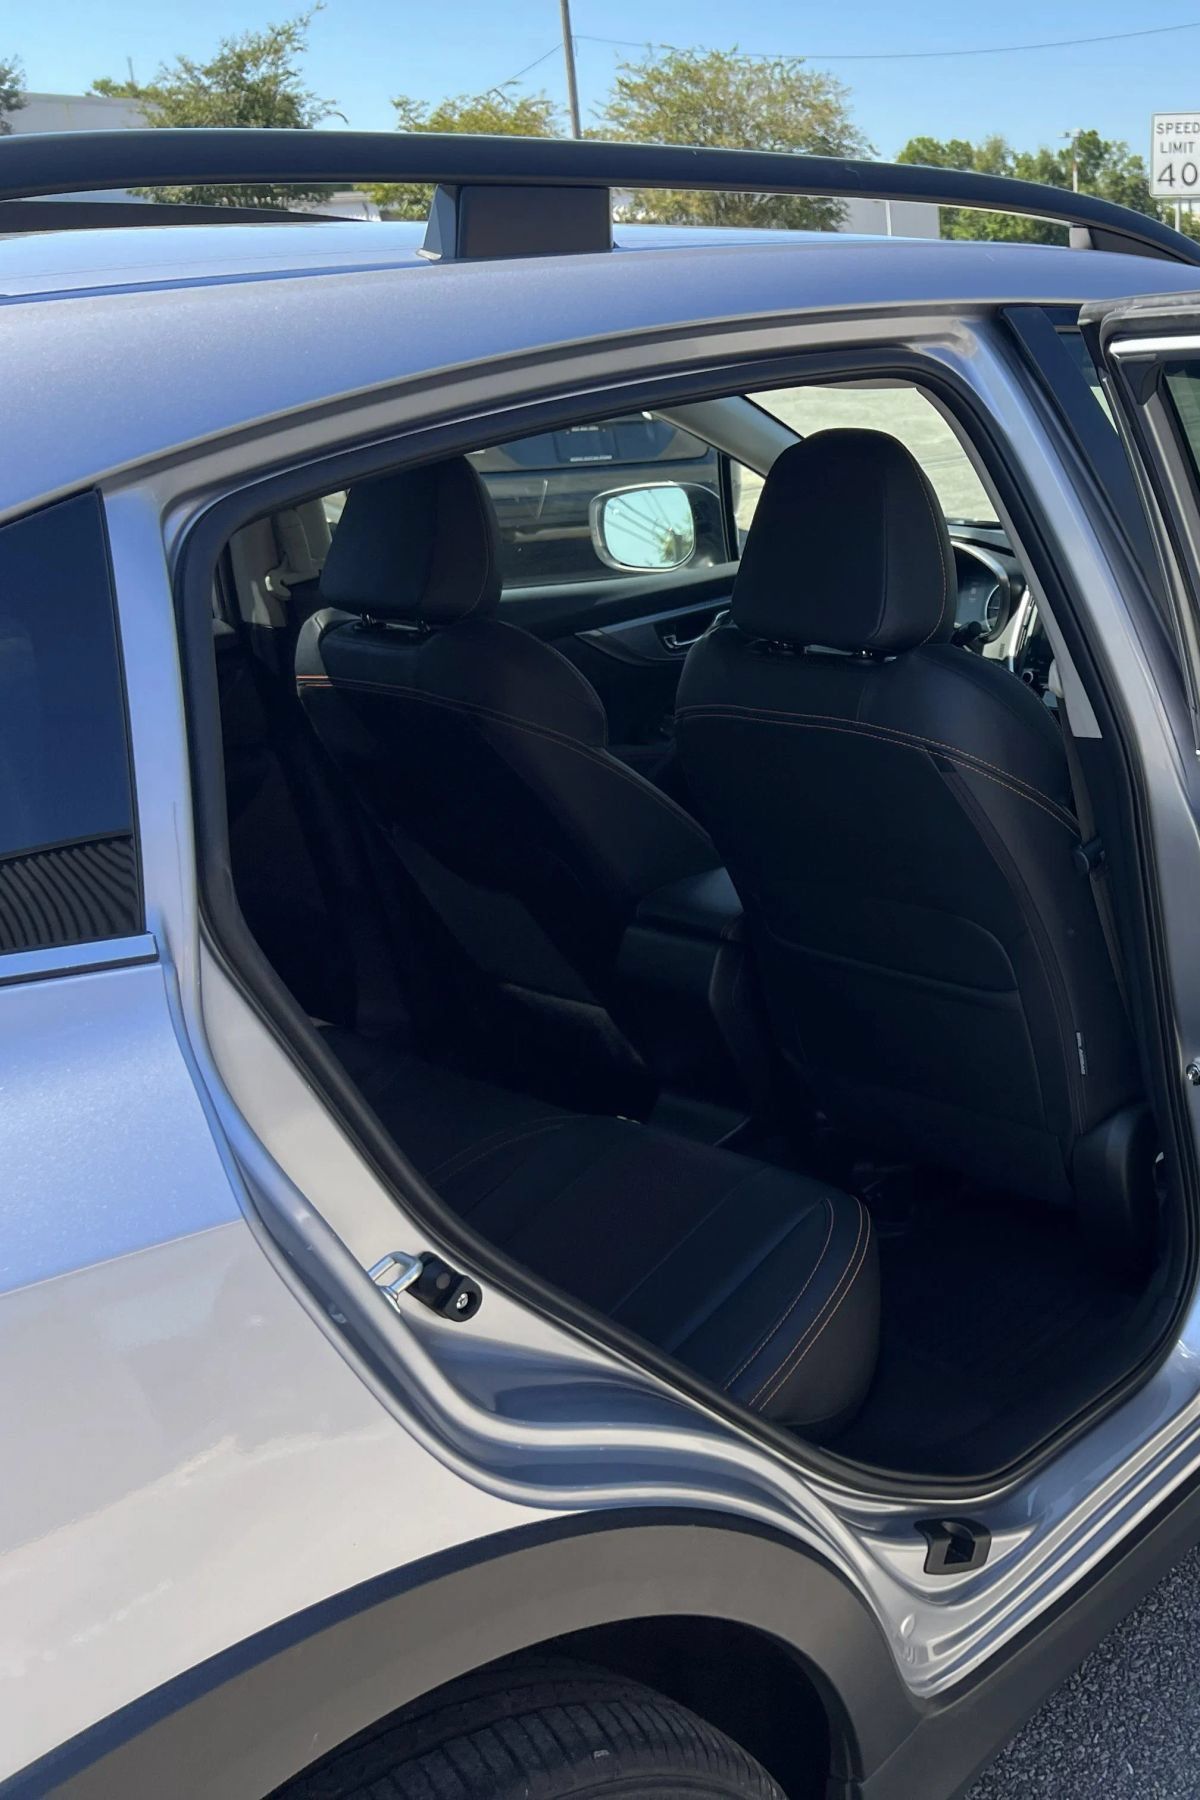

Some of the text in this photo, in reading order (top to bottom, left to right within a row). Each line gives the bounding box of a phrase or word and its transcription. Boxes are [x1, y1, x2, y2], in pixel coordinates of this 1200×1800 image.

[1156, 121, 1200, 135] SPEED
[1160, 141, 1195, 154] LIMIT
[1157, 161, 1198, 187] 40
